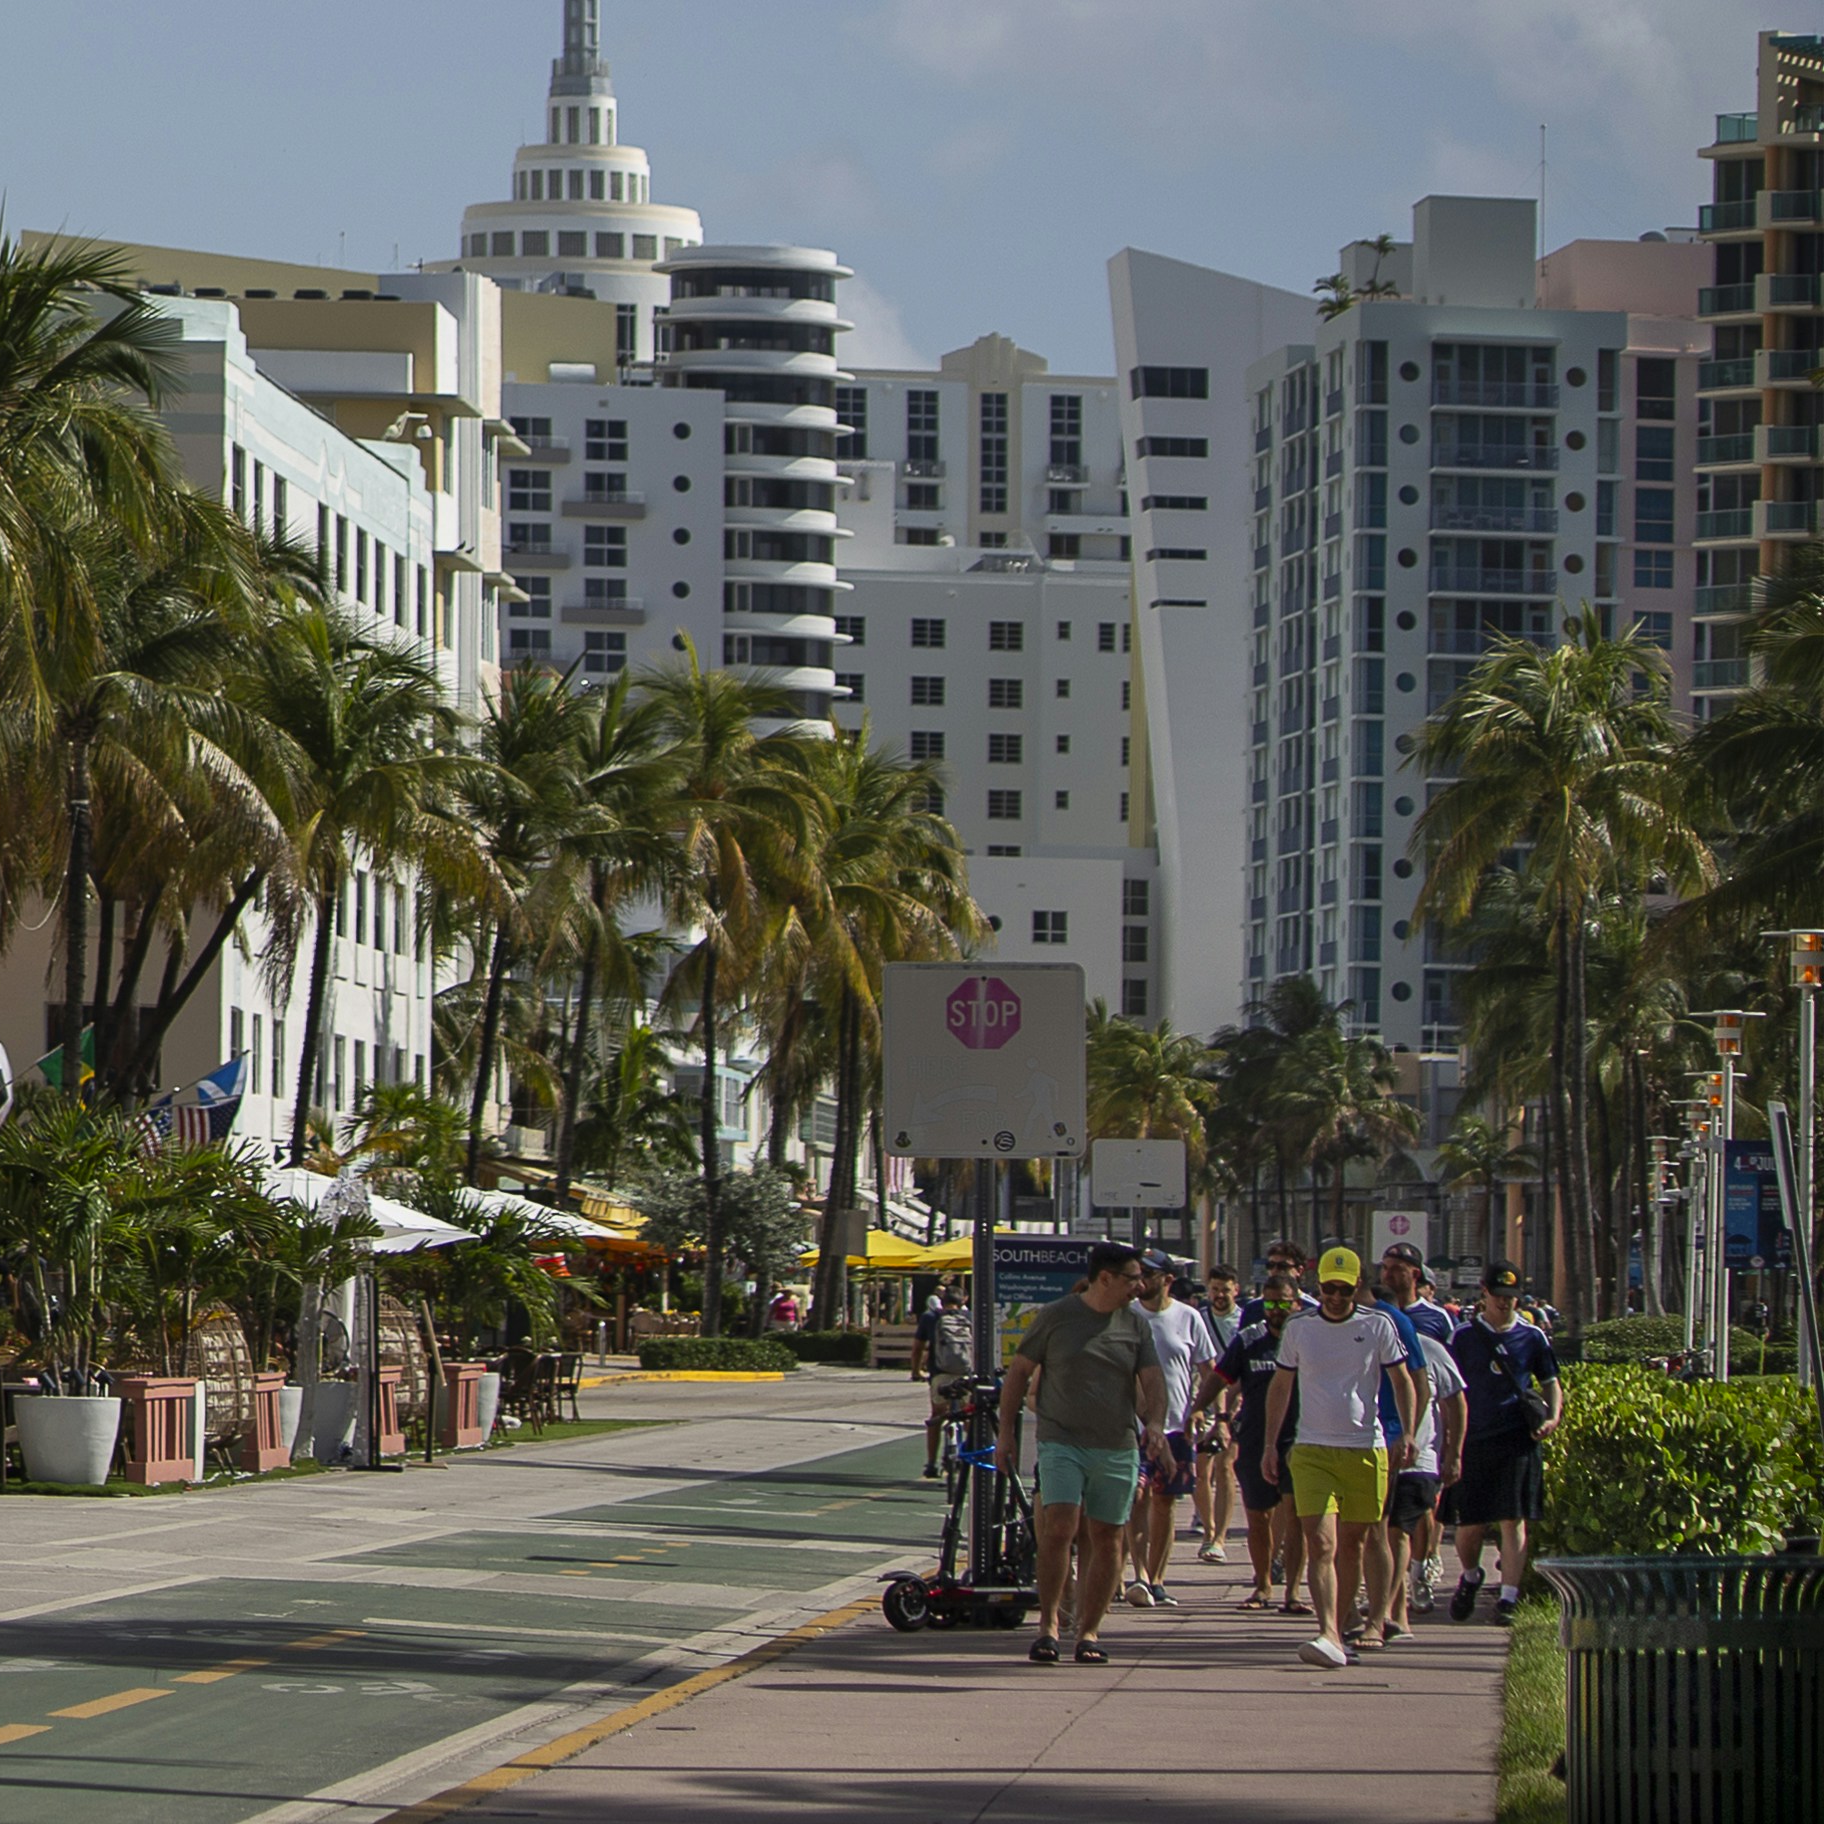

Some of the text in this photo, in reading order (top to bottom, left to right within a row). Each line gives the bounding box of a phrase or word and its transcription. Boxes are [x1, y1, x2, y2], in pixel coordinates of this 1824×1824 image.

[950, 1000, 1018, 1027] STOP
[1757, 1155, 1776, 1171] JUL
[999, 1283, 1037, 1292] Washington
